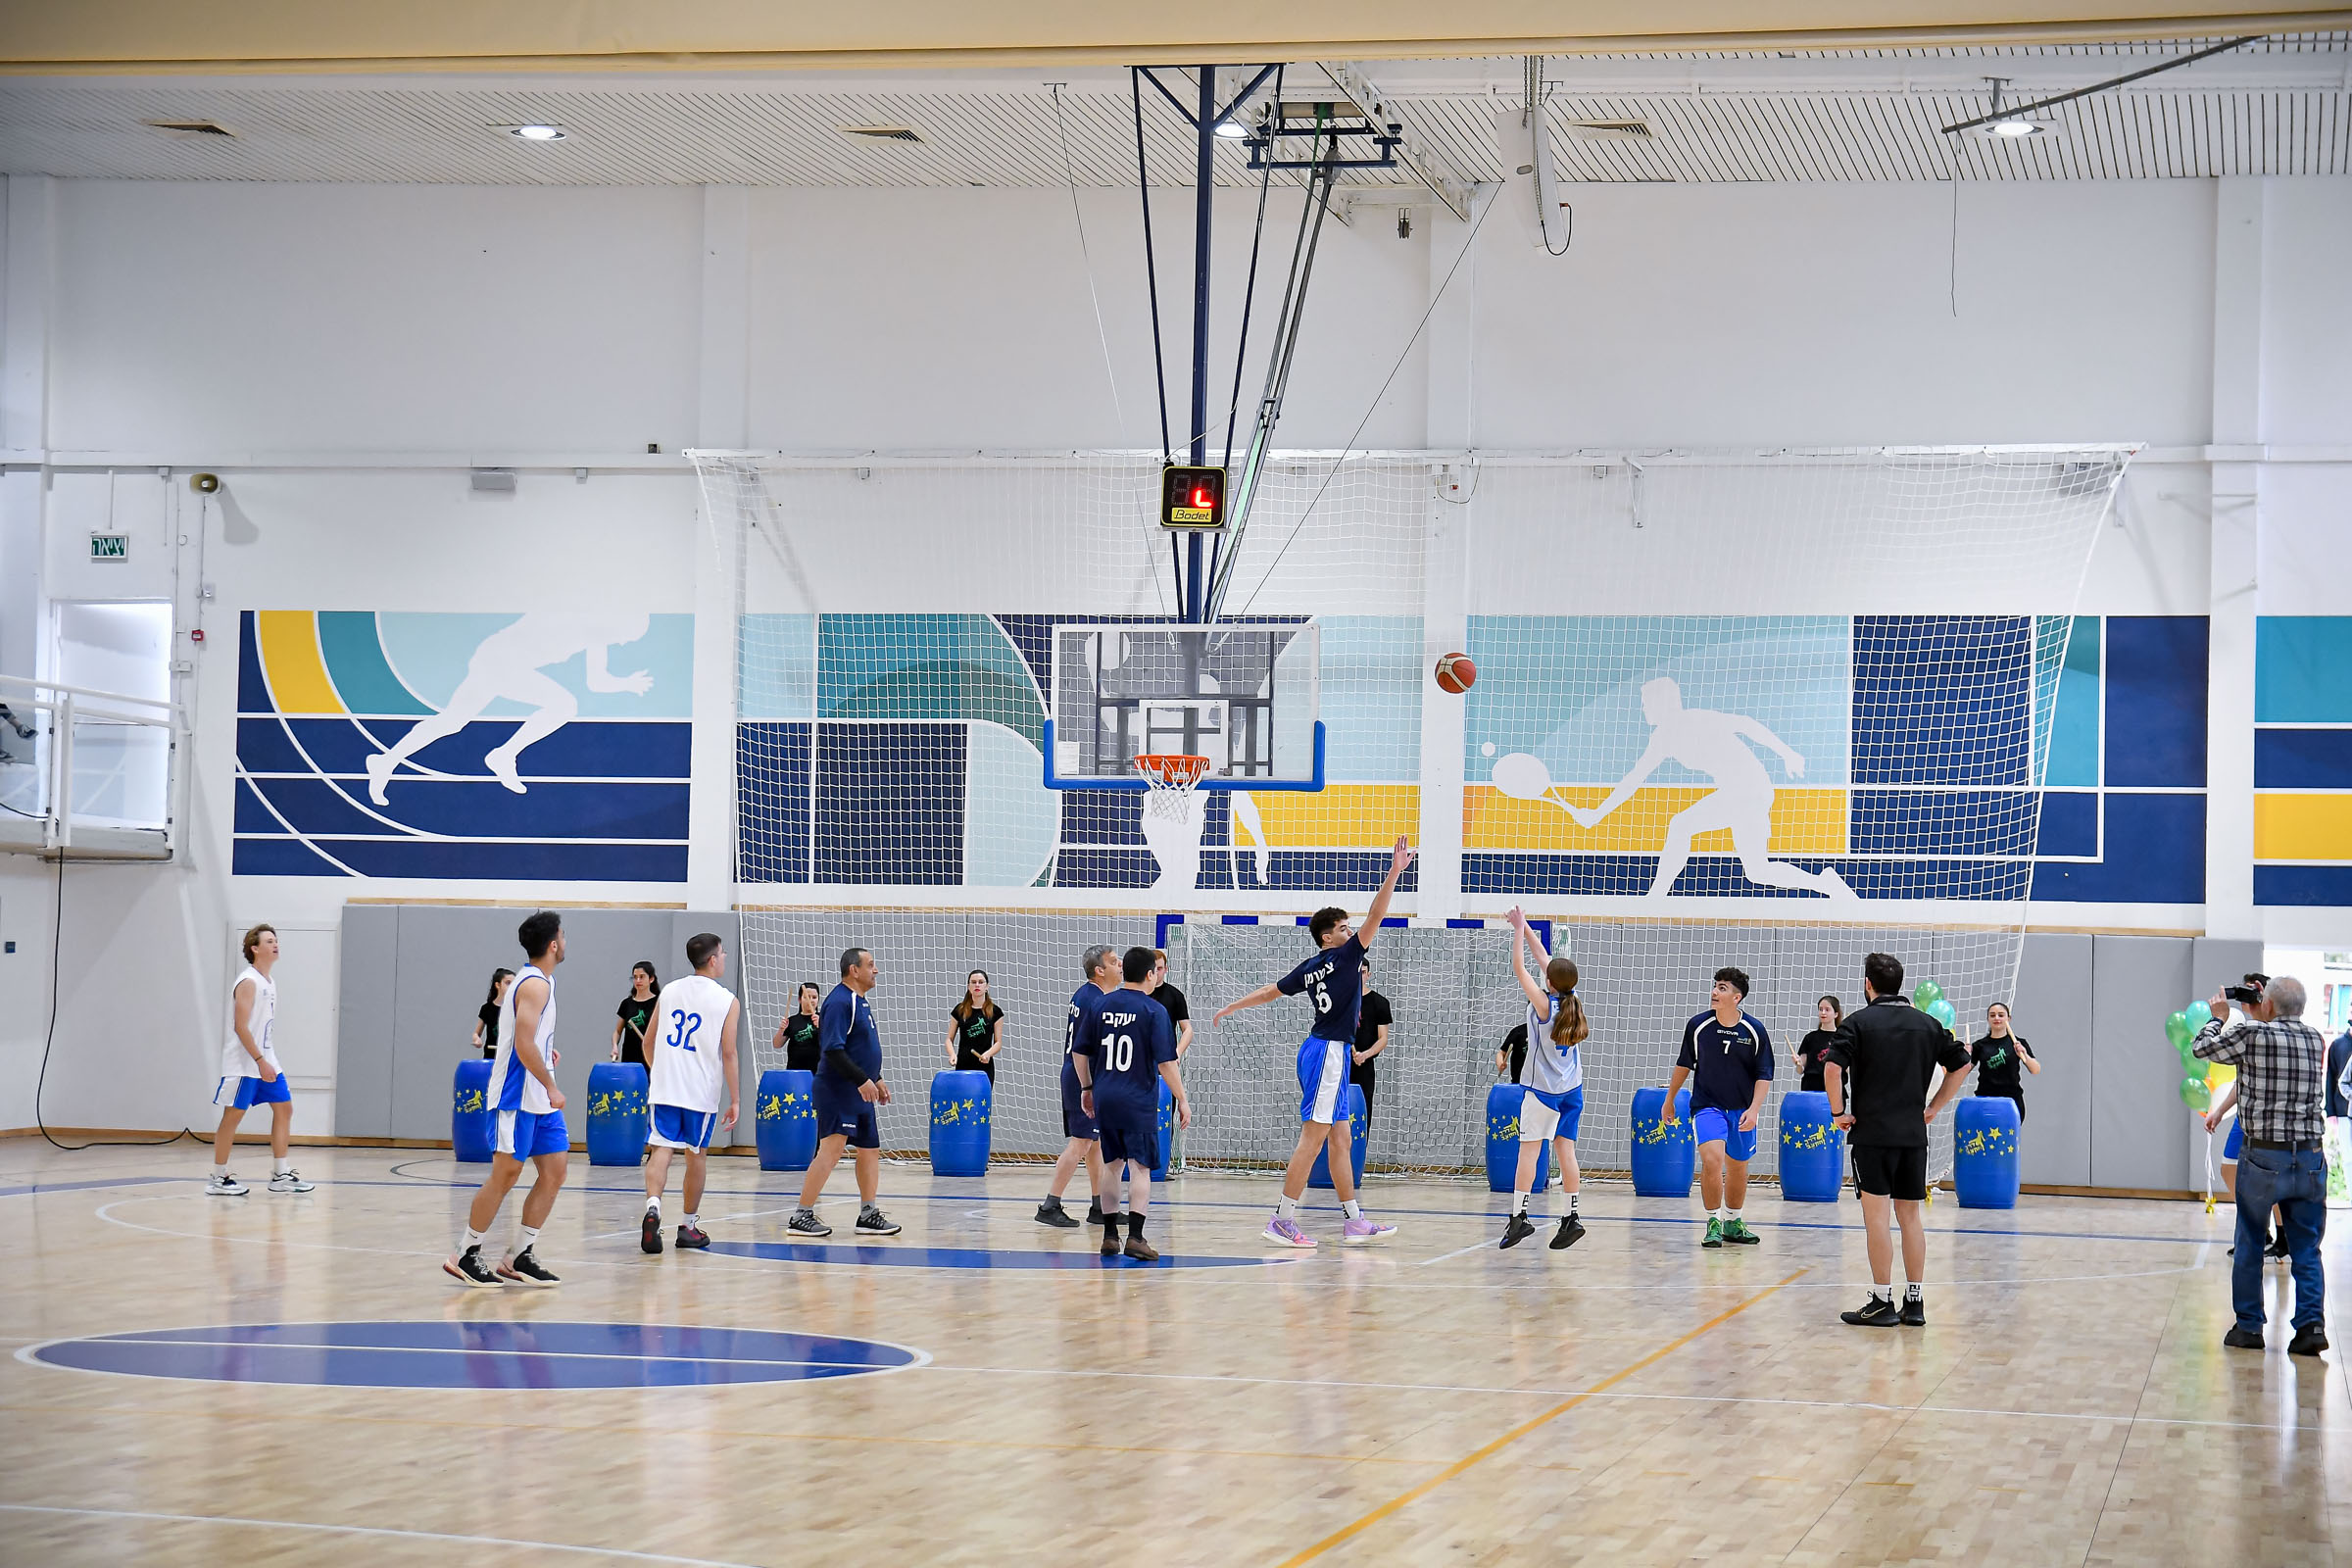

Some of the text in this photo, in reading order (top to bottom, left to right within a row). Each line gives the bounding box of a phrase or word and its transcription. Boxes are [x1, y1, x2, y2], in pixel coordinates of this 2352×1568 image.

[1174, 509, 1210, 520] Bodet
[92, 538, 124, 556] יציאה
[1315, 981, 1333, 1014] 6
[1102, 1011, 1137, 1028] יעקבי
[666, 1008, 703, 1052] 32
[1101, 1033, 1134, 1072] 10
[1722, 1040, 1732, 1054] 7
